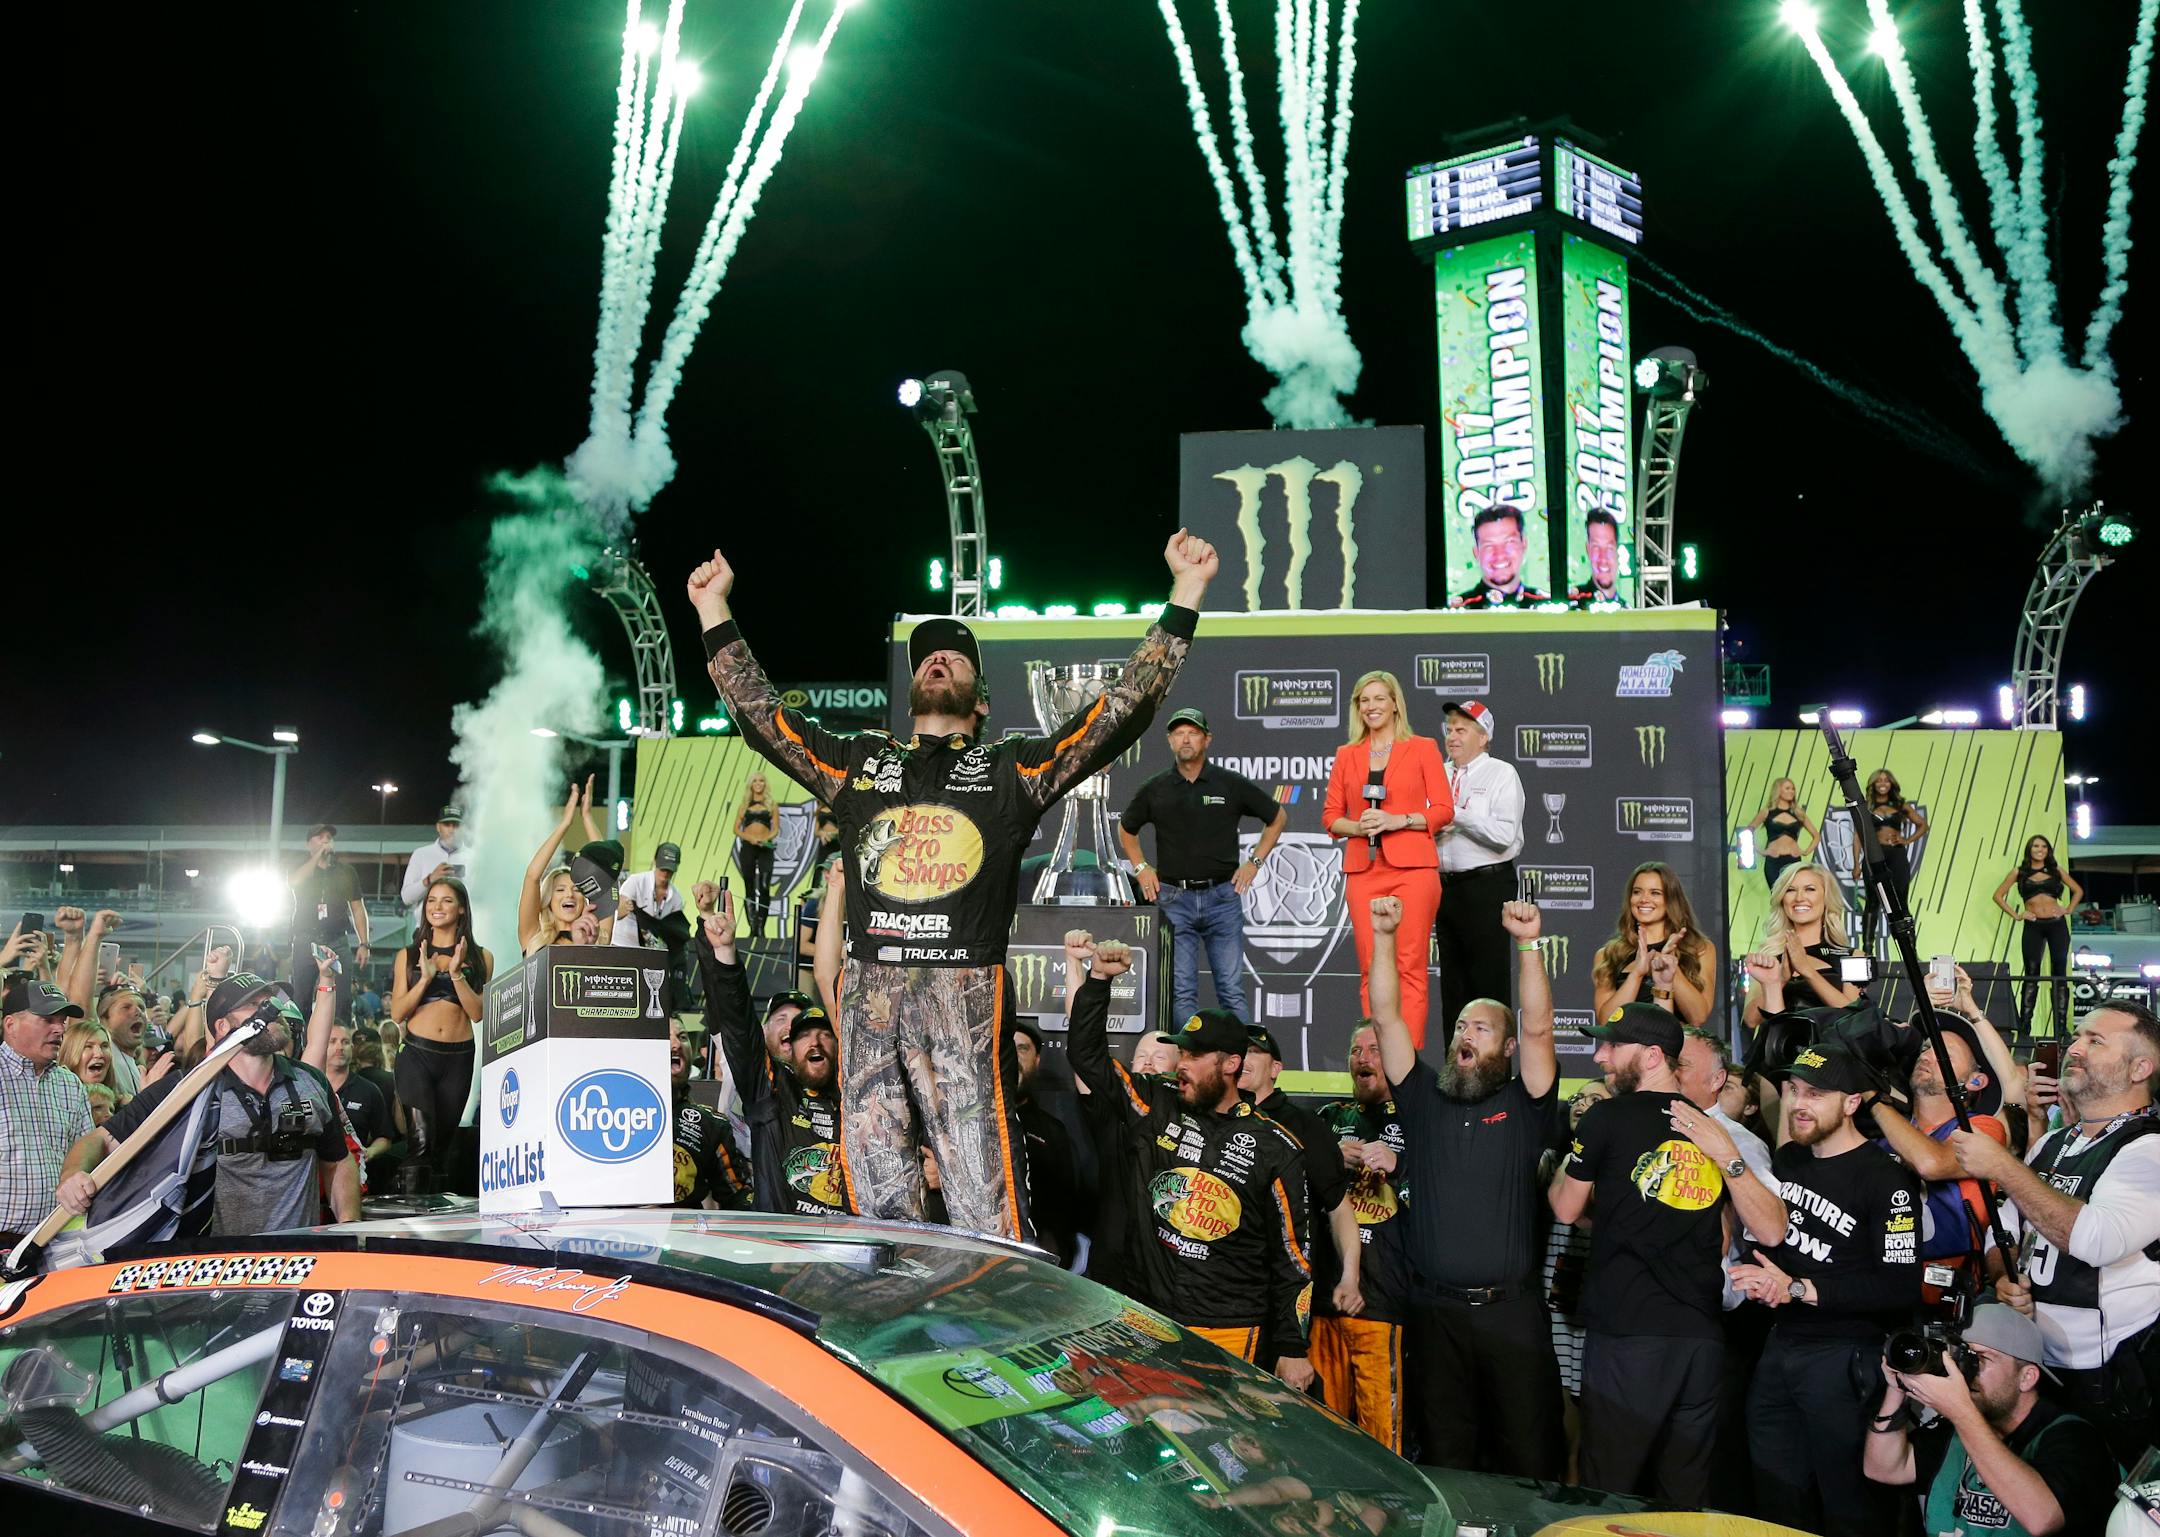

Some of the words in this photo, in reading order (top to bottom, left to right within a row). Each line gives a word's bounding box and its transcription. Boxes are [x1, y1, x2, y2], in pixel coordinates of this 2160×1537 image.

[1460, 197, 1532, 228] Keselowski
[1487, 265, 1537, 514] CHAMPION
[1596, 278, 1628, 525] CHAMPION
[1575, 403, 1603, 512] 2017
[1456, 412, 1496, 519] 2017
[1441, 660, 1485, 668] MONSTER
[1621, 666, 1667, 678] HOMESTEAD
[1272, 679, 1334, 690] MONSTER
[1620, 679, 1664, 688] MIAMI
[807, 688, 888, 708] VISION
[1280, 718, 1325, 727] CHAMPION
[1542, 731, 1587, 740] MONSTER
[945, 784, 993, 793] GOODYEAR
[1643, 804, 1689, 813] MONSTER
[897, 809, 954, 834] Bass
[897, 834, 941, 859] Pro
[894, 858, 968, 890] Shops
[1544, 872, 1589, 881] MONSTER
[907, 932, 949, 940] boats
[905, 948, 947, 959] TRUEX
[950, 949, 969, 960] JR.
[584, 975, 634, 985] MONSTER
[1110, 988, 1135, 997] SERIES
[580, 1008, 637, 1017] CHAMPIONSHIP
[1553, 1016, 1591, 1025] ONSTER
[501, 1079, 520, 1121] Kroger
[570, 1085, 657, 1151] Kroger
[1379, 1134, 1405, 1144] TOYOTA
[1177, 1150, 1201, 1163] ROW
[1225, 1142, 1255, 1159] TOYOTA
[1670, 1143, 1706, 1166] Bass
[2052, 1144, 2069, 1168] NASCAR
[482, 1141, 545, 1192] ClickList
[1673, 1161, 1700, 1182] Pro
[1213, 1167, 1247, 1185] GOODYEAR
[1189, 1172, 1233, 1200] Bass
[1672, 1179, 1714, 1206] Shops
[1185, 1191, 1217, 1213] Pro
[1780, 1181, 1858, 1238] RNITURE
[1890, 1206, 1912, 1214] TOYOTA
[1181, 1207, 1233, 1236] Shops
[1884, 1231, 1916, 1240] FURNITURE
[1784, 1223, 1833, 1264] OW
[1884, 1238, 1916, 1250] ROW
[1882, 1256, 1917, 1264] MATTRESS
[1885, 1249, 1914, 1257] DENVER
[291, 1317, 334, 1331] TOYOTA
[270, 1416, 305, 1427] MERCURY
[681, 1404, 713, 1426] Furniture
[712, 1416, 730, 1431] Row
[664, 1455, 699, 1479] DENVER
[232, 1516, 264, 1530] ENERGY
